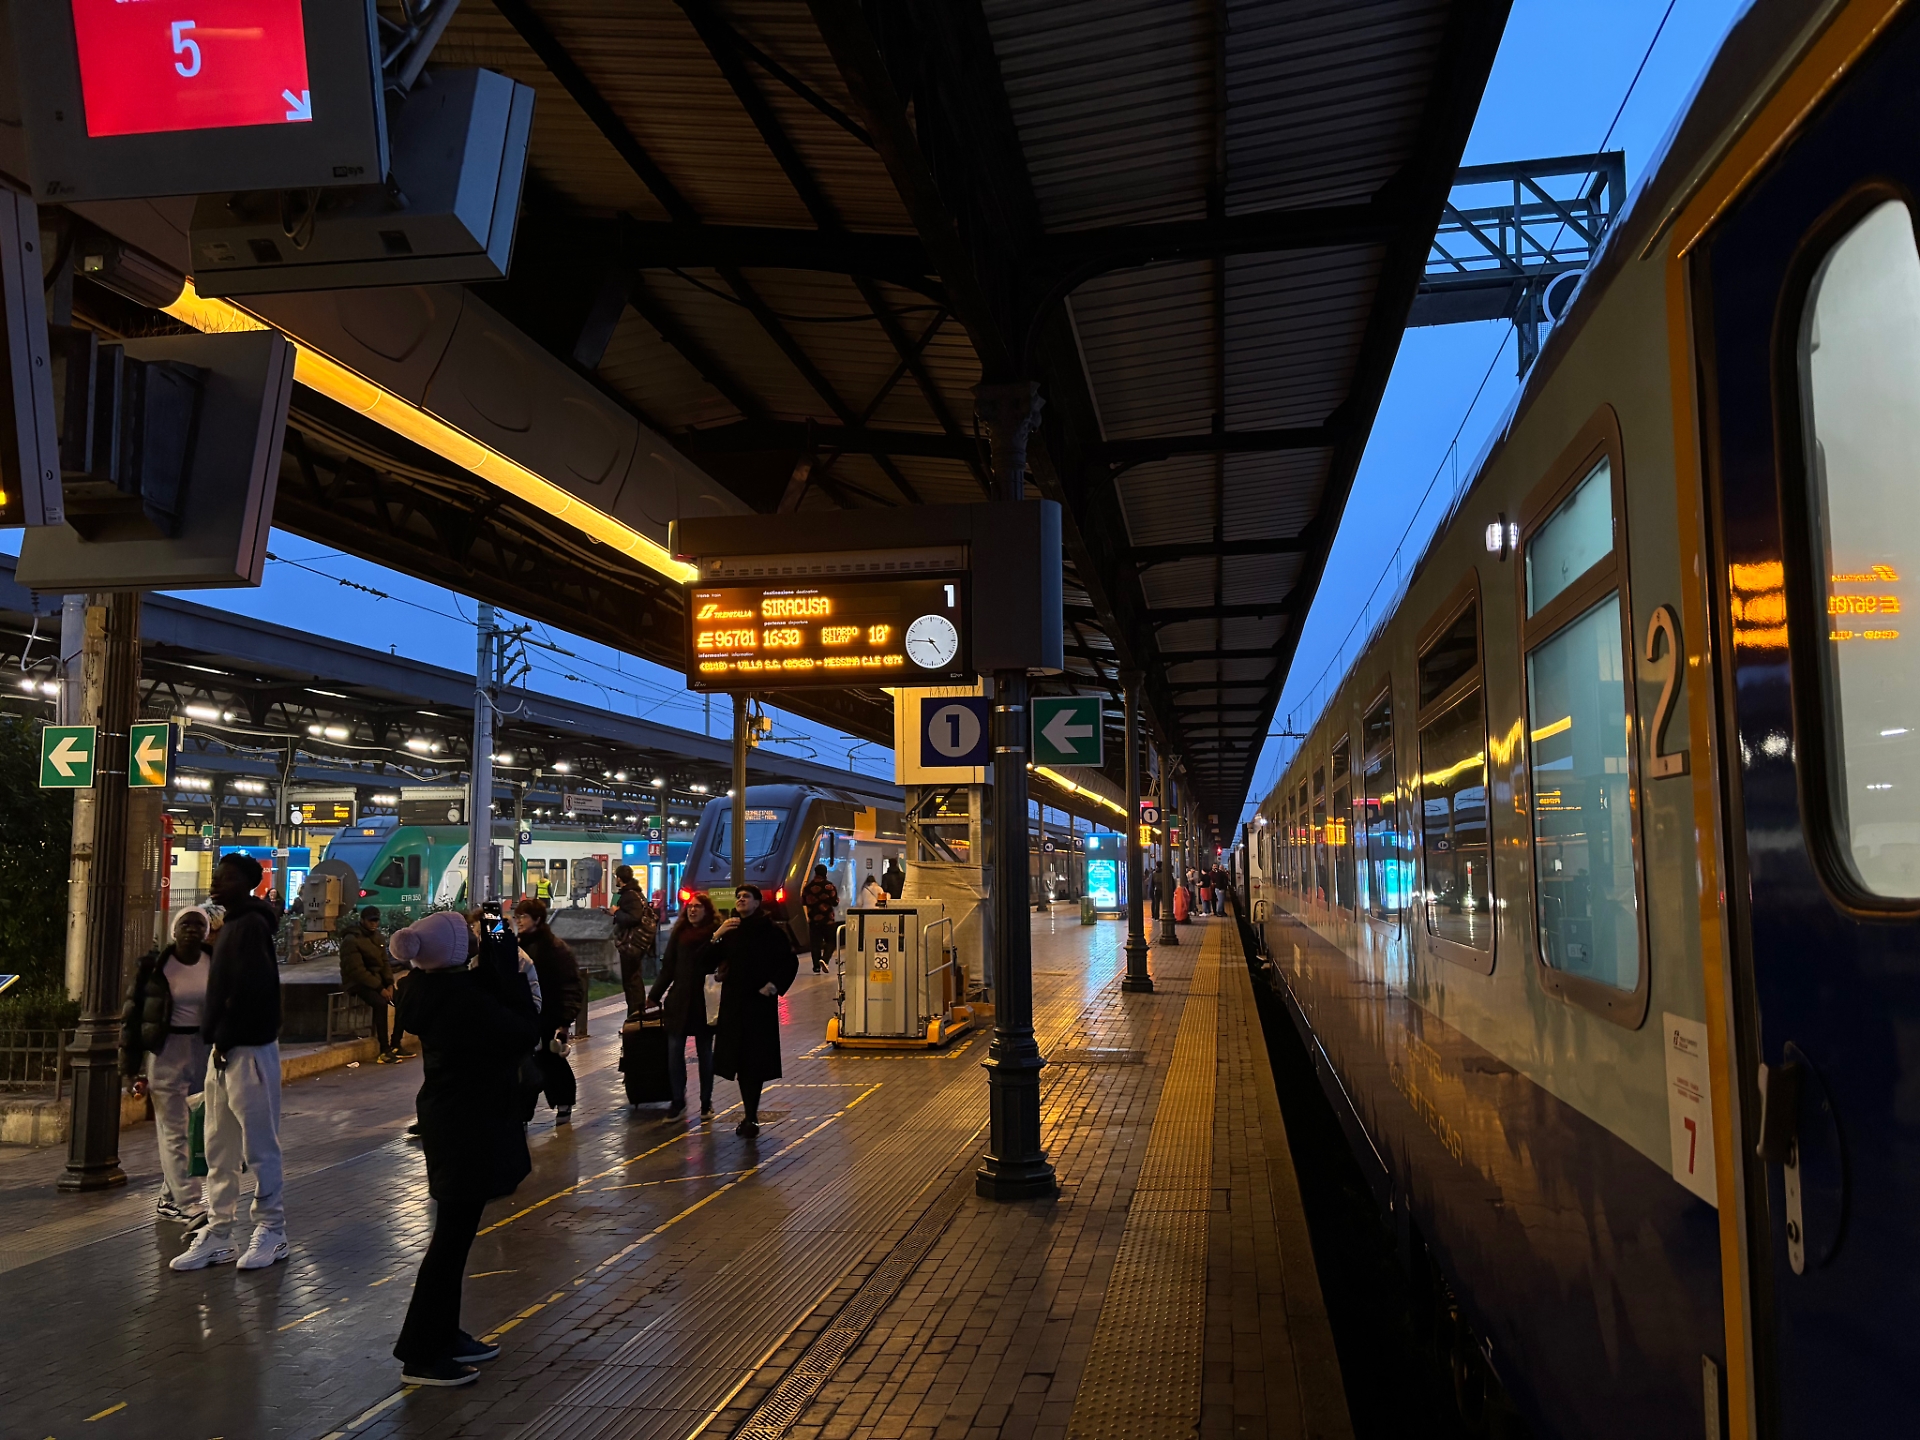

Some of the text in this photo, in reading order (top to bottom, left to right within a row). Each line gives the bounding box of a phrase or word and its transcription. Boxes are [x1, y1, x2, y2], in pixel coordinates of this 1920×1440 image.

[171, 20, 201, 77] 5
[944, 584, 954, 607] 1
[714, 609, 753, 619] TRENITALIA
[762, 597, 829, 616] SIRACUSA
[715, 629, 757, 647] 96701
[763, 629, 800, 647] 16:30
[822, 627, 858, 637] RITARDO
[822, 635, 850, 644] DELAY
[737, 659, 763, 669] VILLA
[824, 656, 860, 668] MESSINA
[1646, 603, 1690, 780] 2
[945, 714, 960, 747] 1
[874, 956, 889, 969] 38
[1438, 1115, 1463, 1168] CAR
[1684, 1116, 1696, 1175] 7
